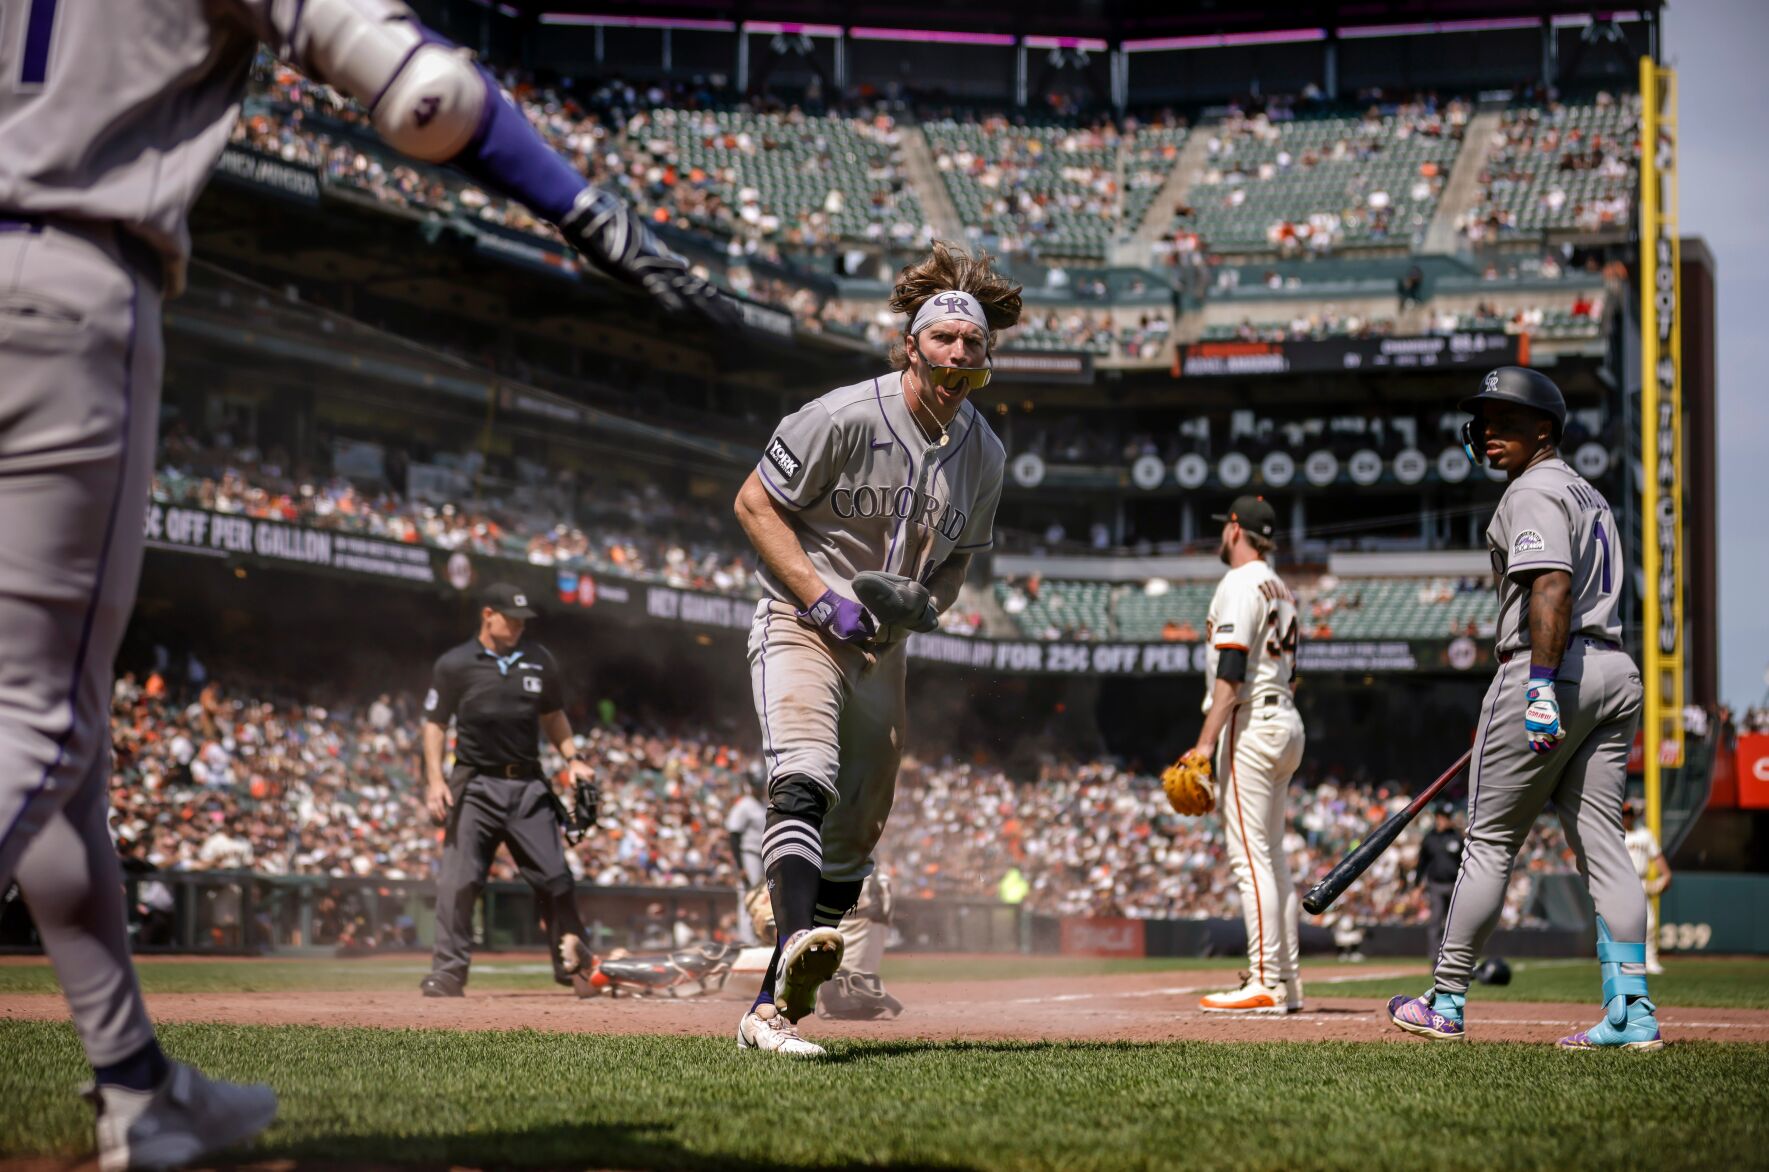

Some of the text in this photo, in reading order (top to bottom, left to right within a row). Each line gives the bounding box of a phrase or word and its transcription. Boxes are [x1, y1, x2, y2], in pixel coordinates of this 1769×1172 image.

[770, 439, 799, 475] YORK
[165, 508, 208, 546] OFF
[211, 514, 252, 552] PER
[254, 522, 332, 566] GALLON
[830, 484, 968, 542] COLORAD
[1593, 520, 1612, 594] 1
[996, 642, 1041, 669] FOR
[1047, 643, 1089, 672] 25¢
[1093, 644, 1138, 672] OFF
[1142, 644, 1190, 672] PER
[1265, 607, 1297, 658] 34
[1658, 922, 1712, 949] 339
